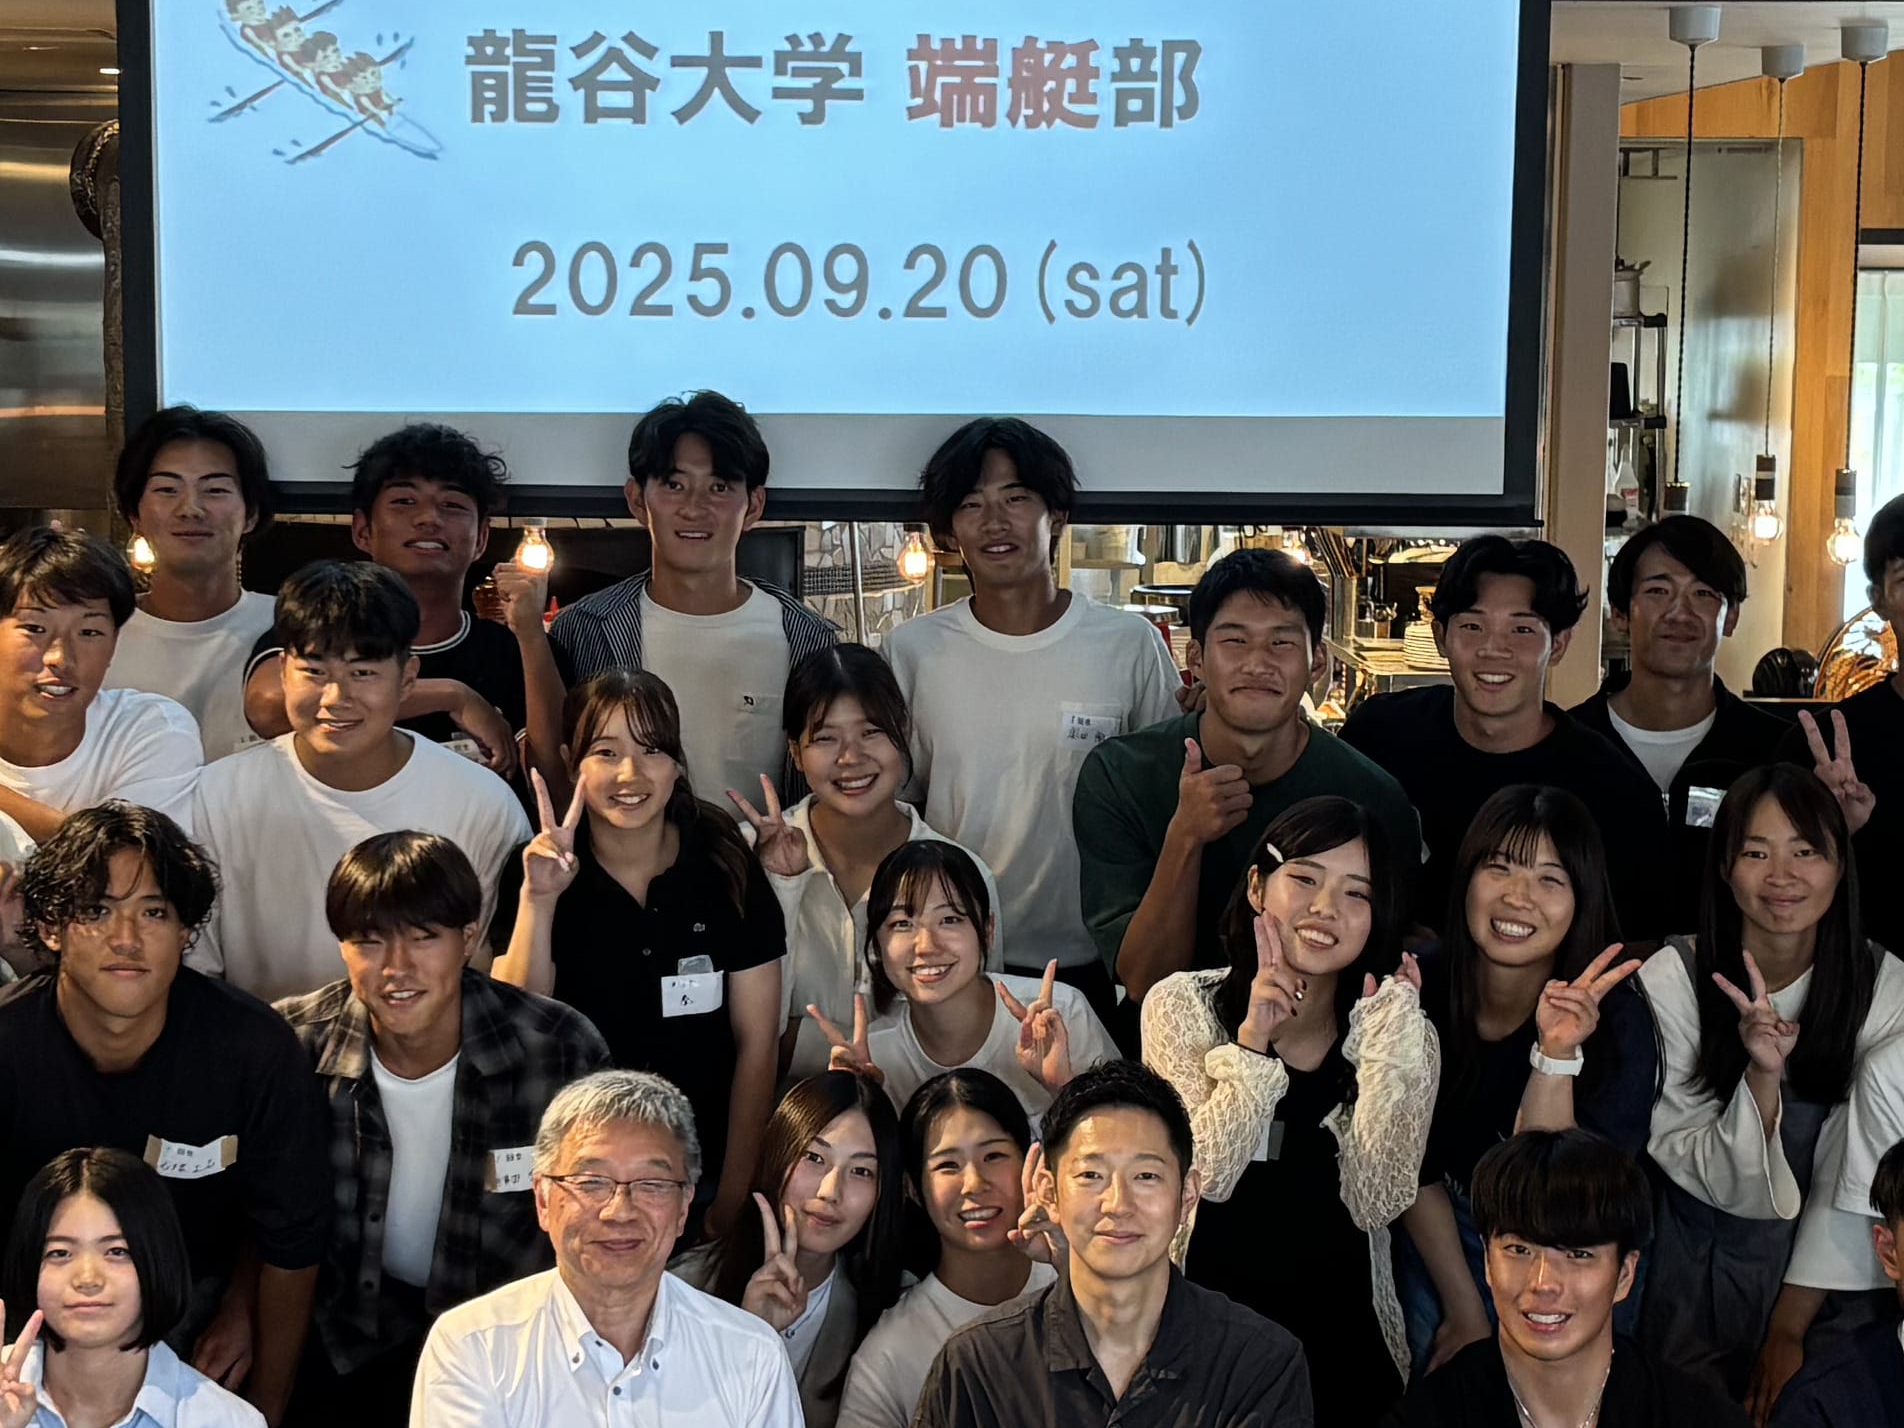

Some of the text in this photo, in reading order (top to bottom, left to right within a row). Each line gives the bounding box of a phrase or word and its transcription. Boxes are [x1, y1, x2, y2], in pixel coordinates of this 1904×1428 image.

[464, 28, 1203, 129] 龍谷大学 端艇部
[511, 238, 1206, 327] 2025.09.20 (sat)
